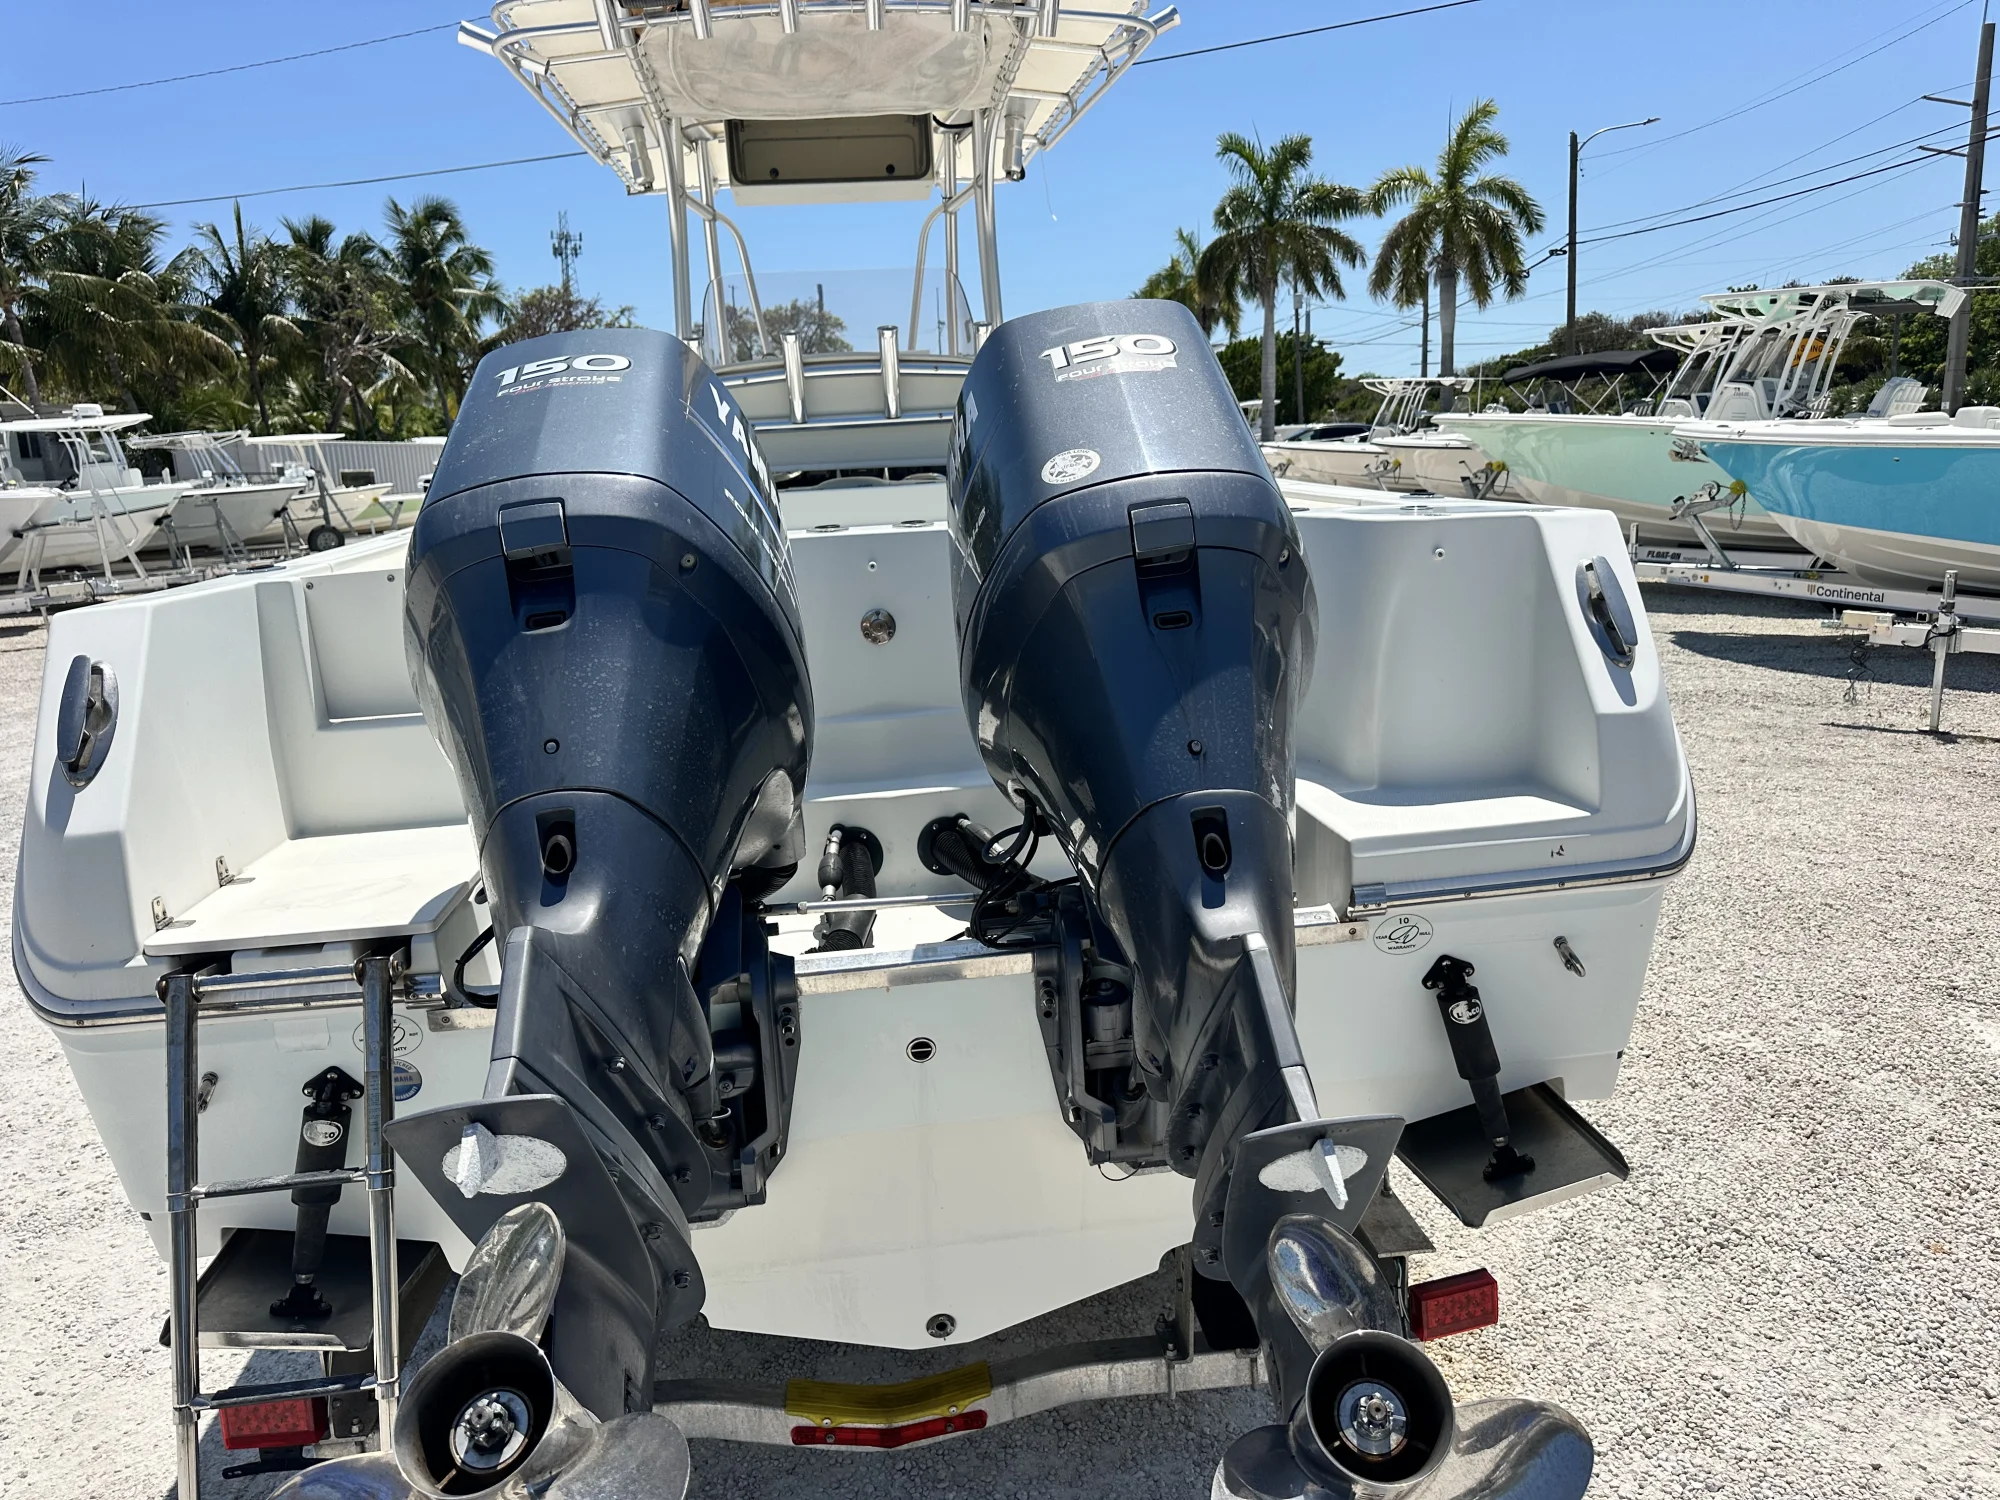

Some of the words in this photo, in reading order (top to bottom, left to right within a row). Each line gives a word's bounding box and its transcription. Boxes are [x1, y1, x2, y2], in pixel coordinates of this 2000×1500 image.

[1038, 334, 1177, 370] 150
[494, 354, 632, 387] 150
[1646, 550, 1682, 560] FLOAT-ON
[1816, 586, 1885, 603] Continental
[1398, 917, 1410, 925] 10
